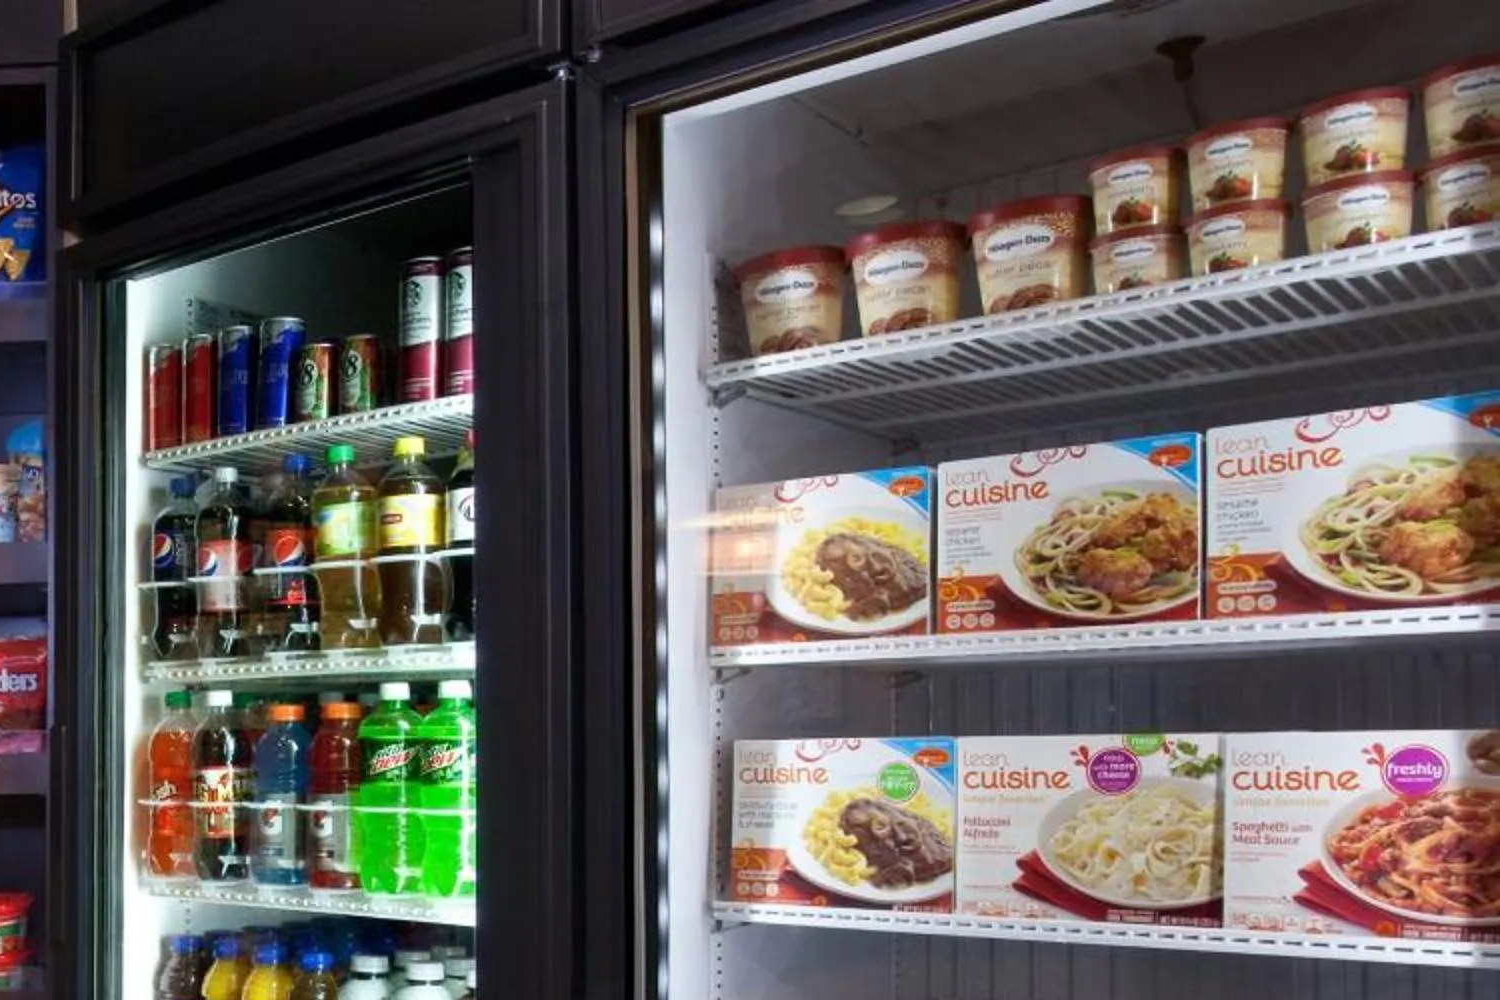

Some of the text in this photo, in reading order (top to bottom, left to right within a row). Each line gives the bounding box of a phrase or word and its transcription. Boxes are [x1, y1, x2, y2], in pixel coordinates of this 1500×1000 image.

[1216, 446, 1344, 480] cuisine
[946, 480, 1050, 509] cuisine
[739, 765, 829, 785] cuisine
[963, 767, 1071, 790] cuisine
[1232, 766, 1360, 791] cuisine
[1387, 760, 1443, 779] freshly
[1231, 821, 1289, 835] Spaghetti
